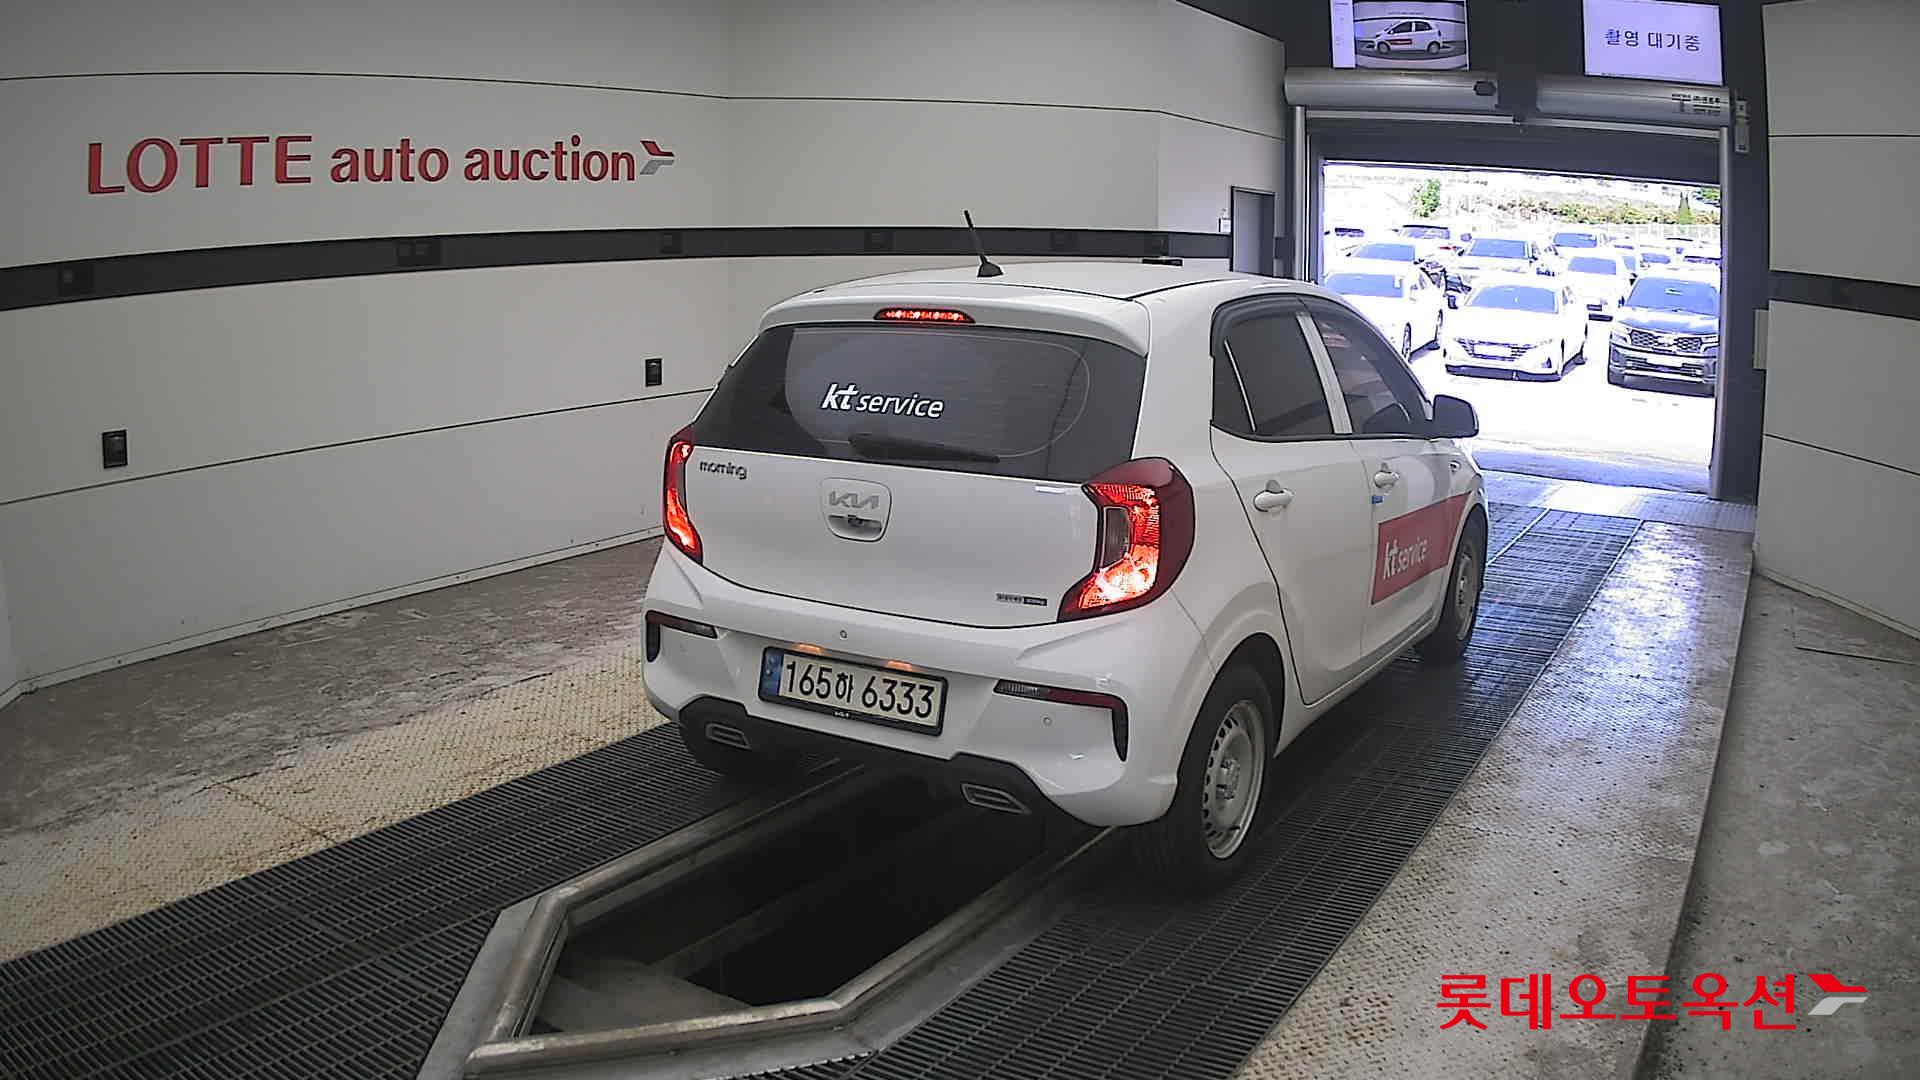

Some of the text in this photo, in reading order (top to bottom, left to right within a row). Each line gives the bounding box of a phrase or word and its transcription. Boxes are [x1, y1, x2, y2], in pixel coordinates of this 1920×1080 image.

[1604, 28, 1701, 52] 촬영 대기중
[87, 136, 636, 195] LOTTE auto auction
[821, 383, 944, 418] kt service
[699, 460, 748, 480] morning
[828, 490, 879, 510] KIA
[1383, 539, 1398, 580] kt
[786, 660, 936, 719] 165하 6333
